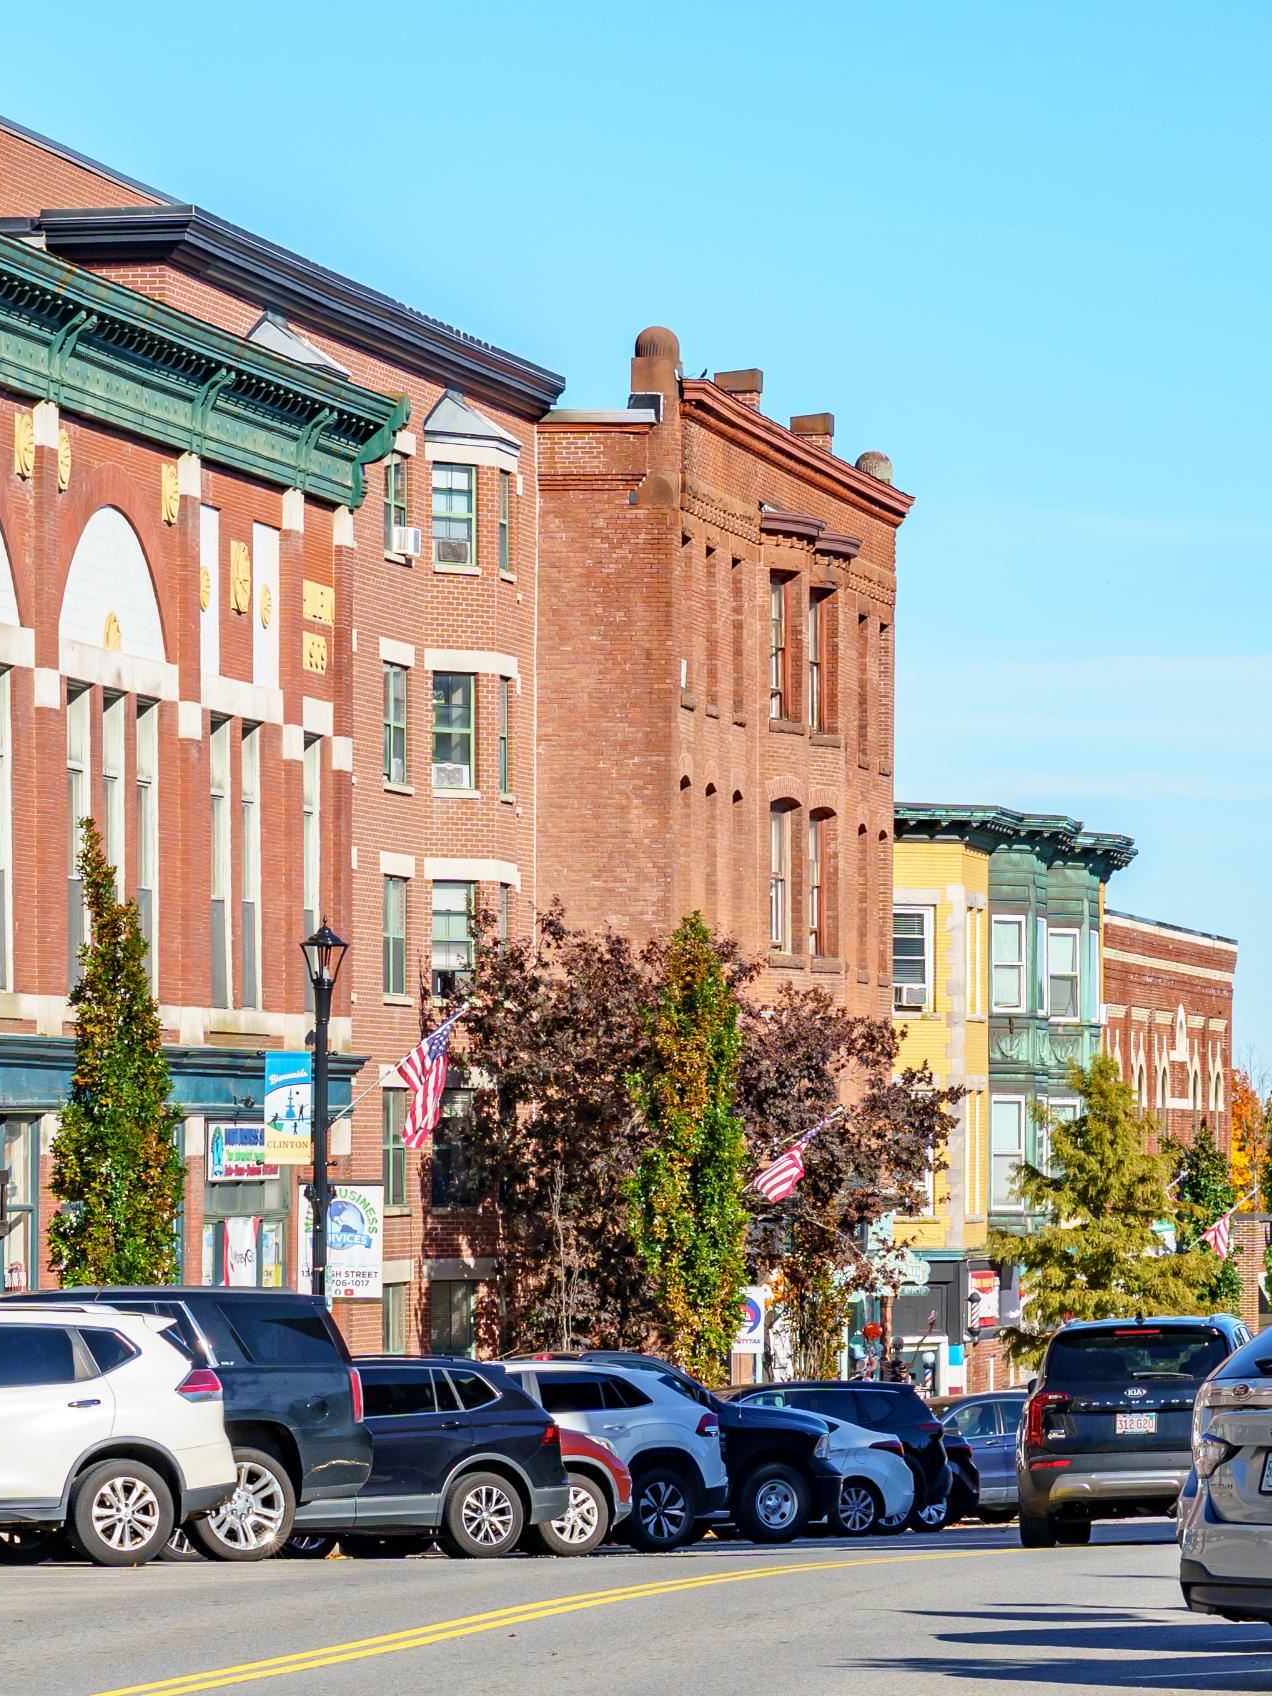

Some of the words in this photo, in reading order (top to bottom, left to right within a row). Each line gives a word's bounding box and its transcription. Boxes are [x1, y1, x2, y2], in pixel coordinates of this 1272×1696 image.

[266, 1141, 308, 1149] CLINTON
[339, 1188, 378, 1234] USINESS
[328, 1233, 368, 1245] RVICES
[1117, 1419, 1134, 1430] 312
